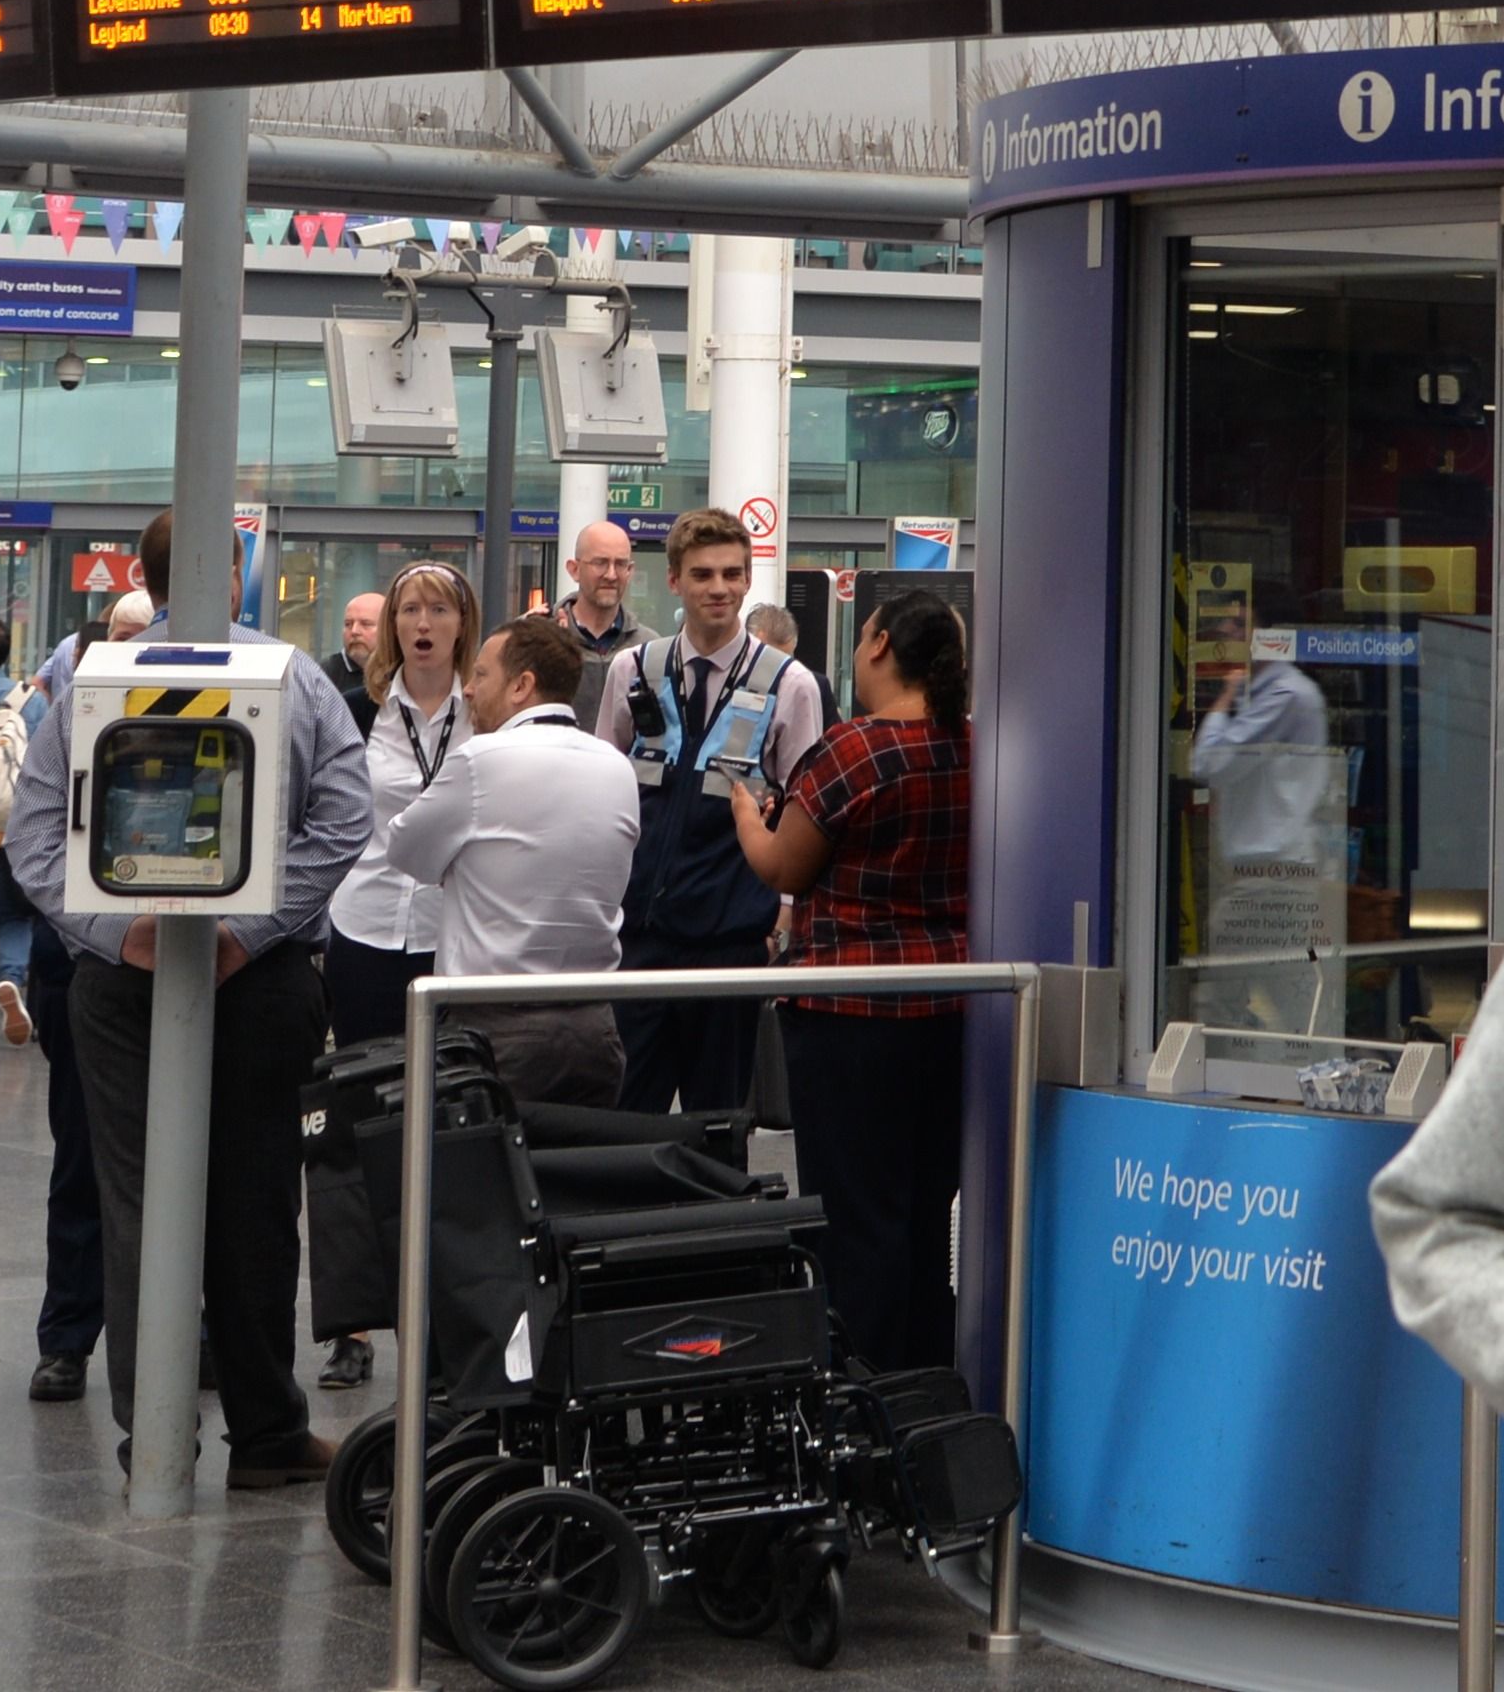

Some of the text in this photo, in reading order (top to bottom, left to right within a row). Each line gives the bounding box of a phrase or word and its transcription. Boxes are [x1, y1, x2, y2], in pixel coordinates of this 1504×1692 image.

[1000, 101, 1164, 172] Information
[16, 280, 50, 294] centre
[53, 282, 84, 295] buses
[18, 307, 51, 319] centre
[53, 306, 65, 320] of
[67, 309, 119, 322] concourse
[1306, 635, 1355, 656] Position
[1113, 1157, 1300, 1227] We hope you
[1109, 1233, 1327, 1293] enjoy your visit
